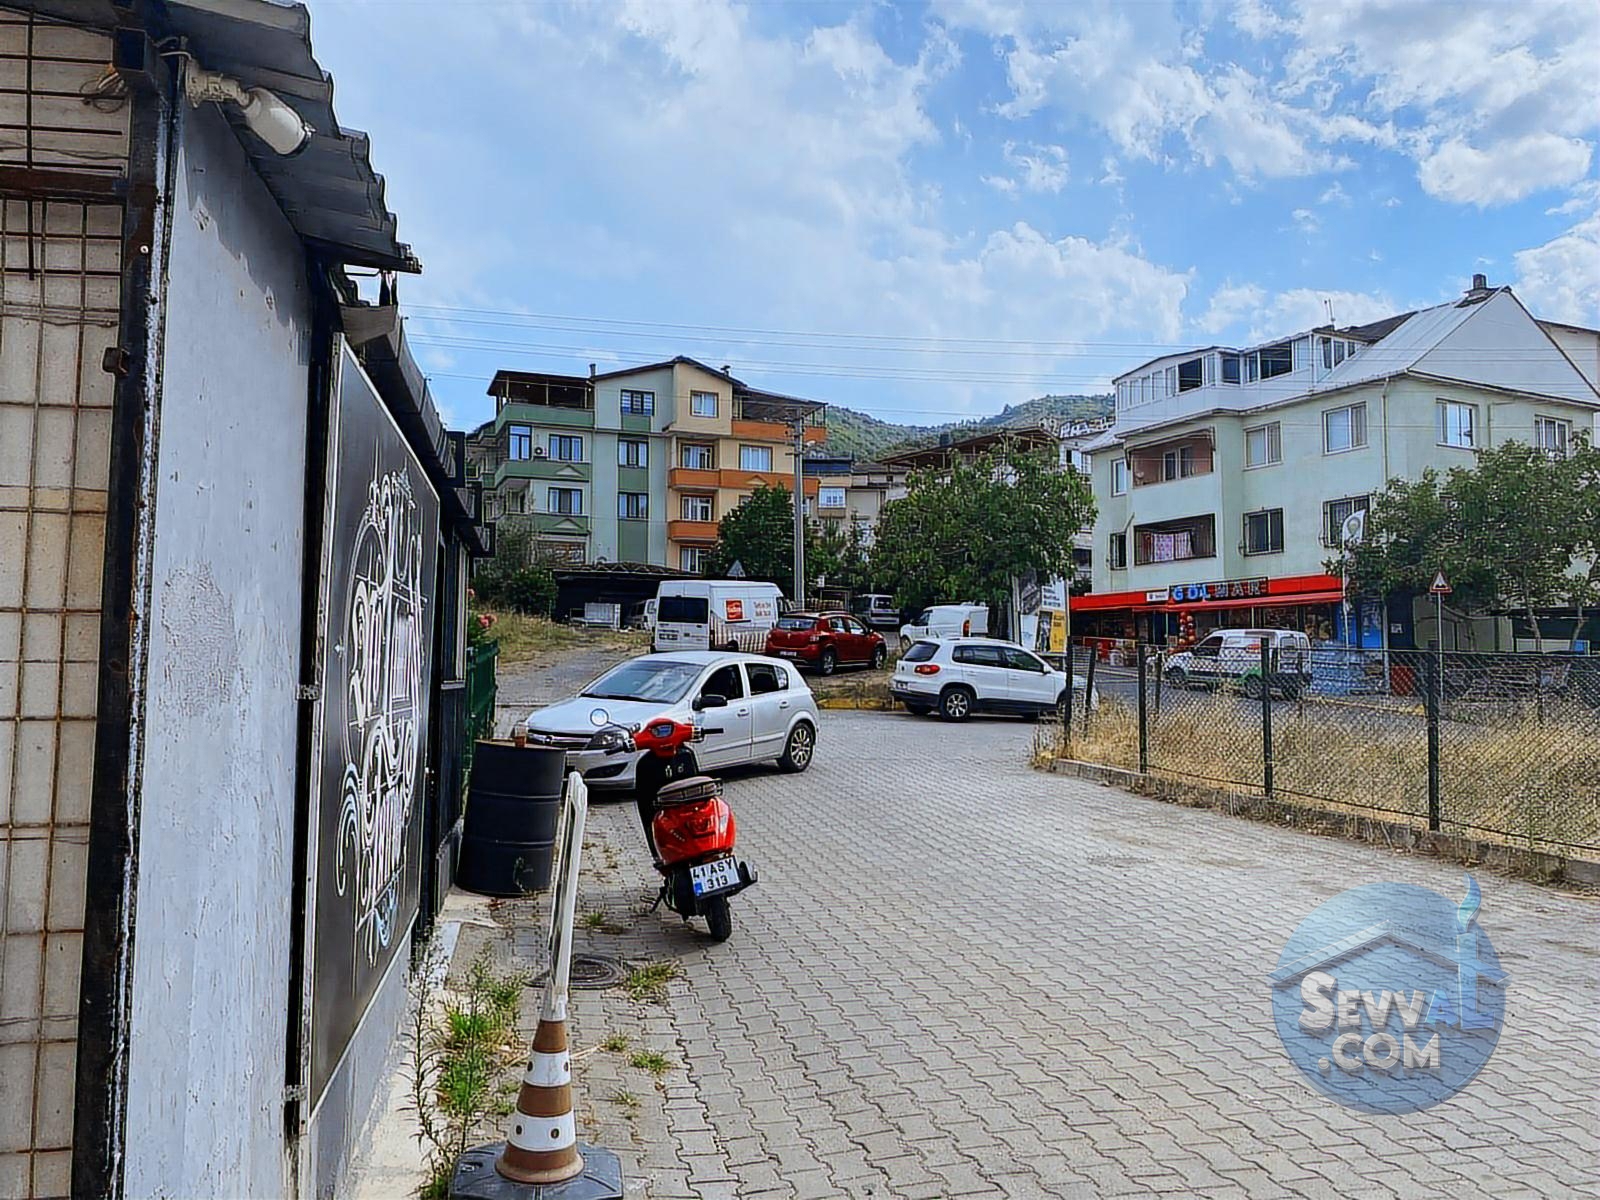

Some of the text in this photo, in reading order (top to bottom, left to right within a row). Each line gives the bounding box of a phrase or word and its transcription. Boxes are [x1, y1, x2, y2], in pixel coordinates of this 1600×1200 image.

[692, 858, 732, 879] 41 ASY
[706, 874, 729, 889] 313
